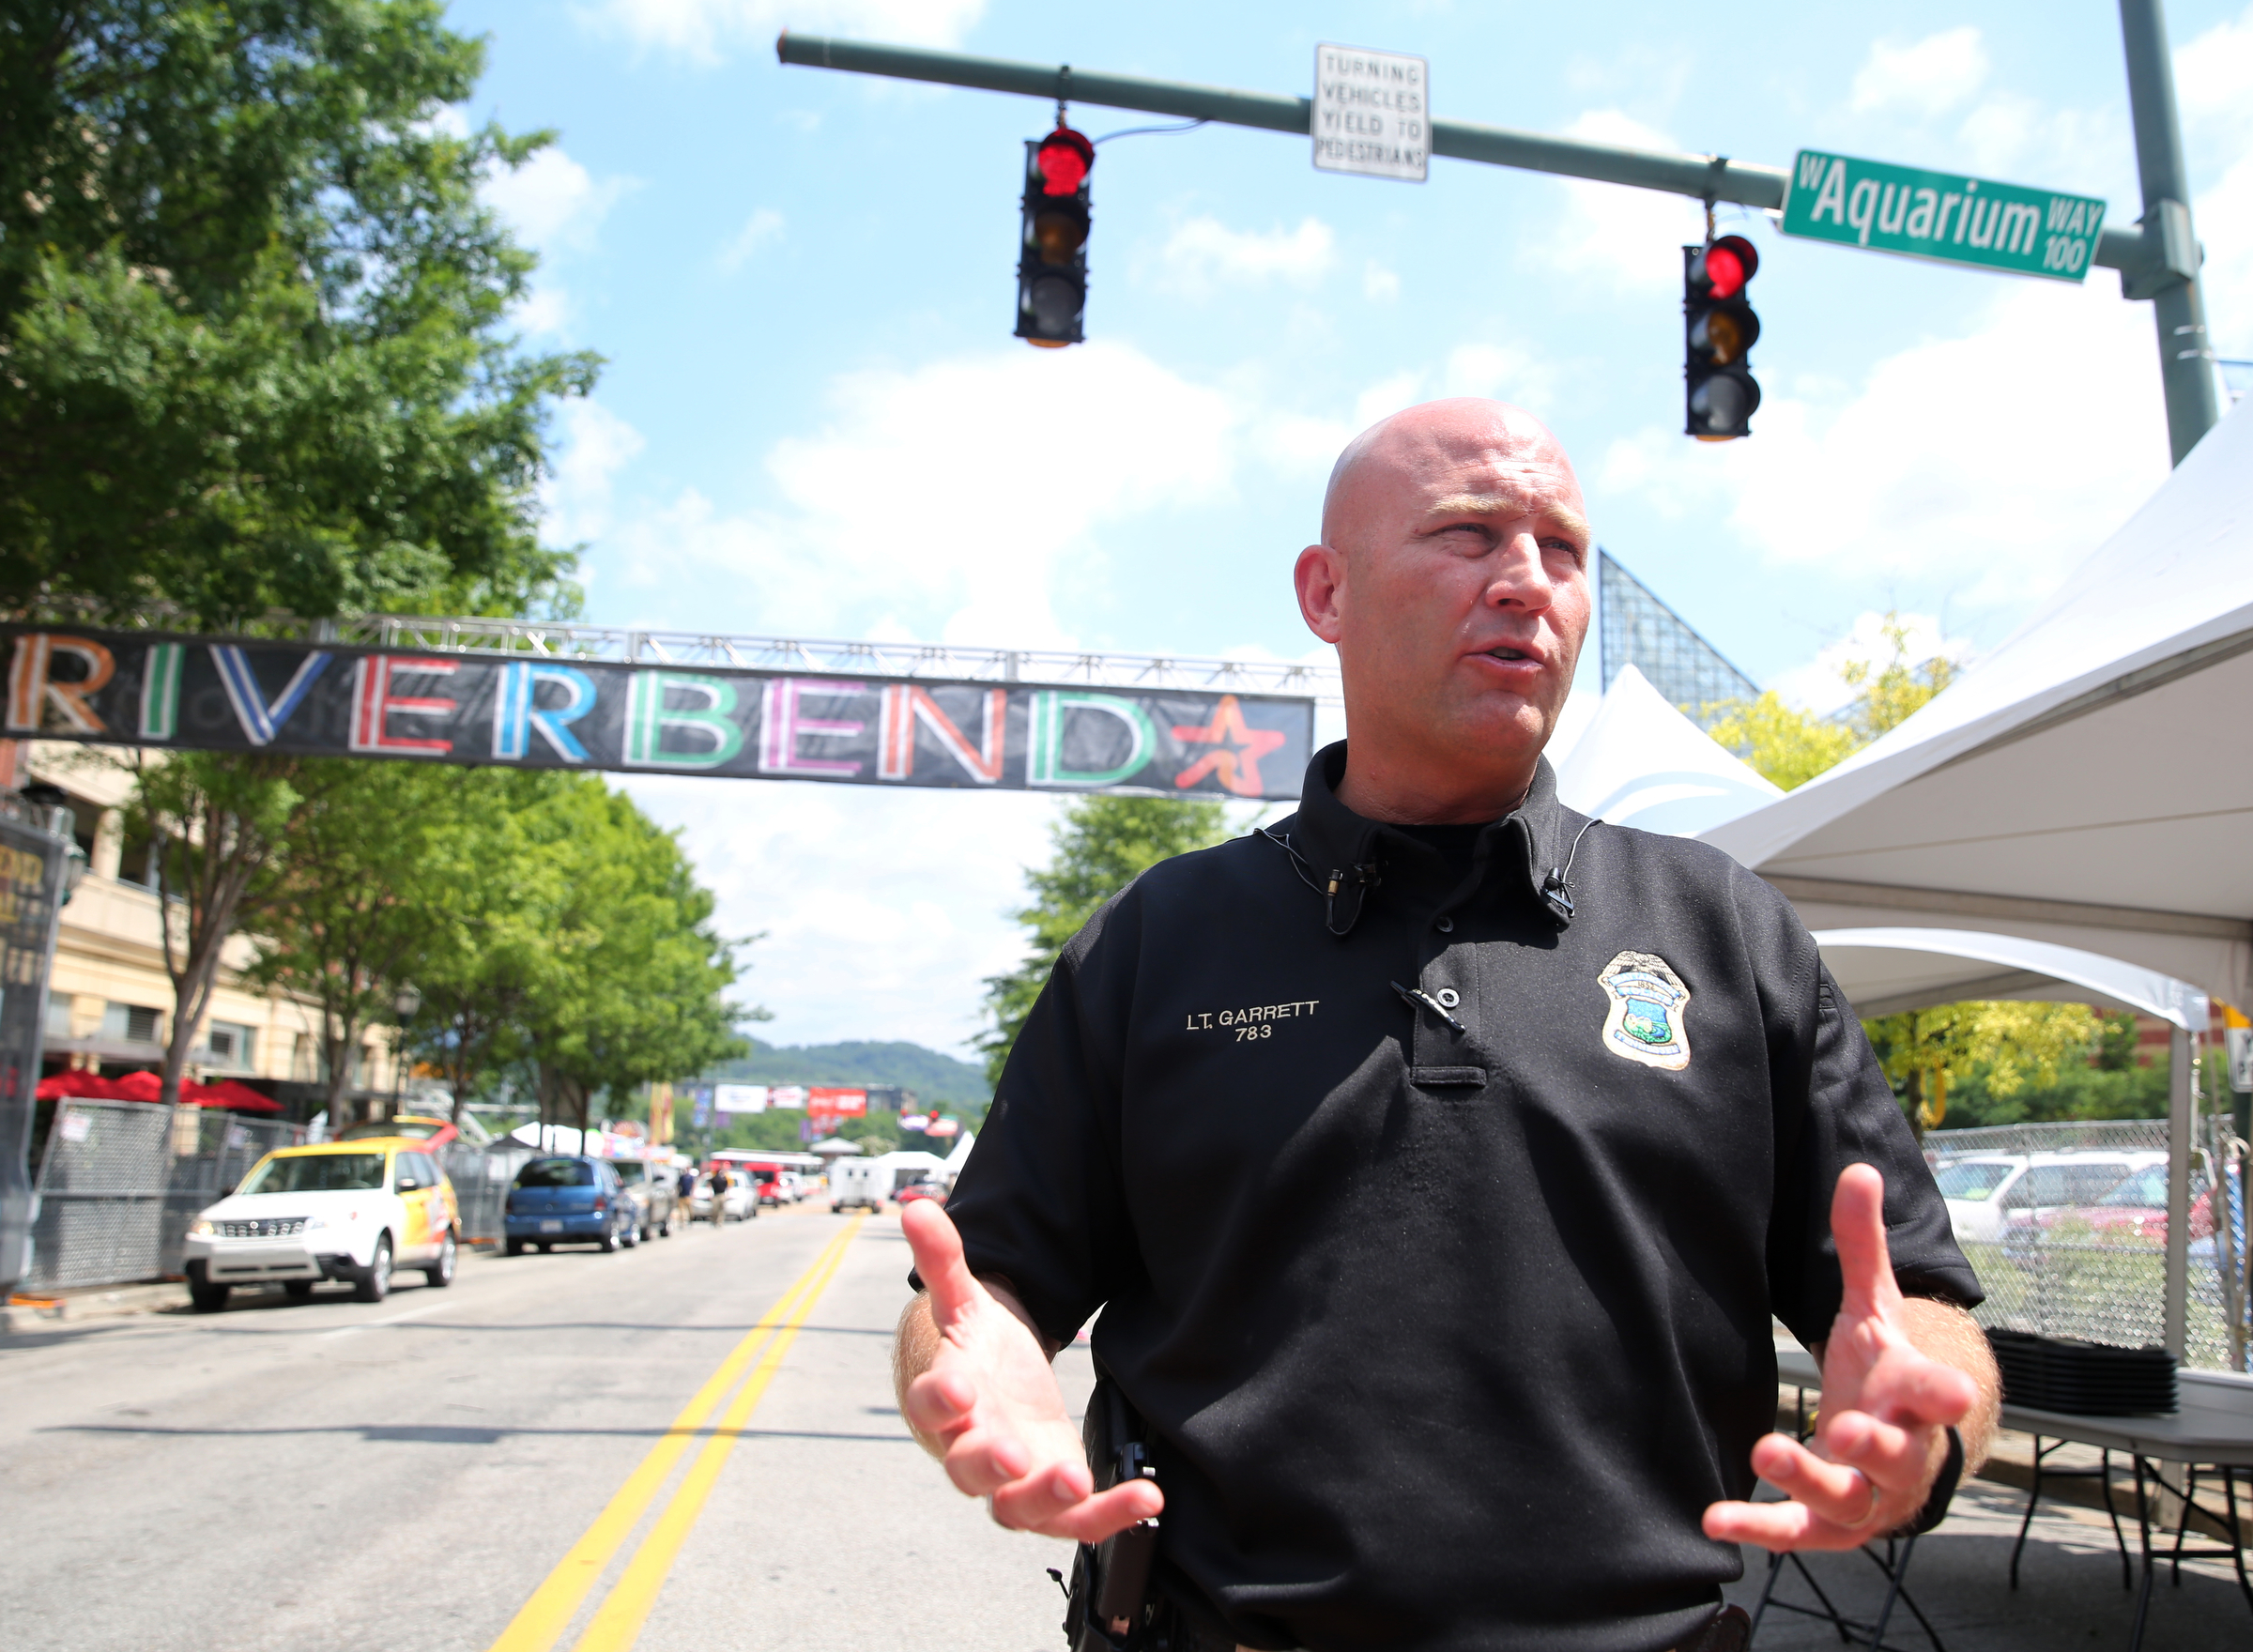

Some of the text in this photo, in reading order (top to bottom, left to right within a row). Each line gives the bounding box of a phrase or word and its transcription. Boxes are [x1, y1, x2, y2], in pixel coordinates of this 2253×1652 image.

[1326, 55, 1419, 85] TURNING
[1322, 82, 1421, 113] VEHICLES
[1322, 109, 1422, 141] YIELD TO
[1317, 138, 1425, 170] PEDESTRIANS
[1799, 153, 2104, 255] W Aquarium WAY
[2043, 236, 2087, 273] 100
[7, 633, 1157, 788] RIVERBEND
[1219, 1000, 1319, 1026] GARRETT
[1234, 1024, 1272, 1042] 783
